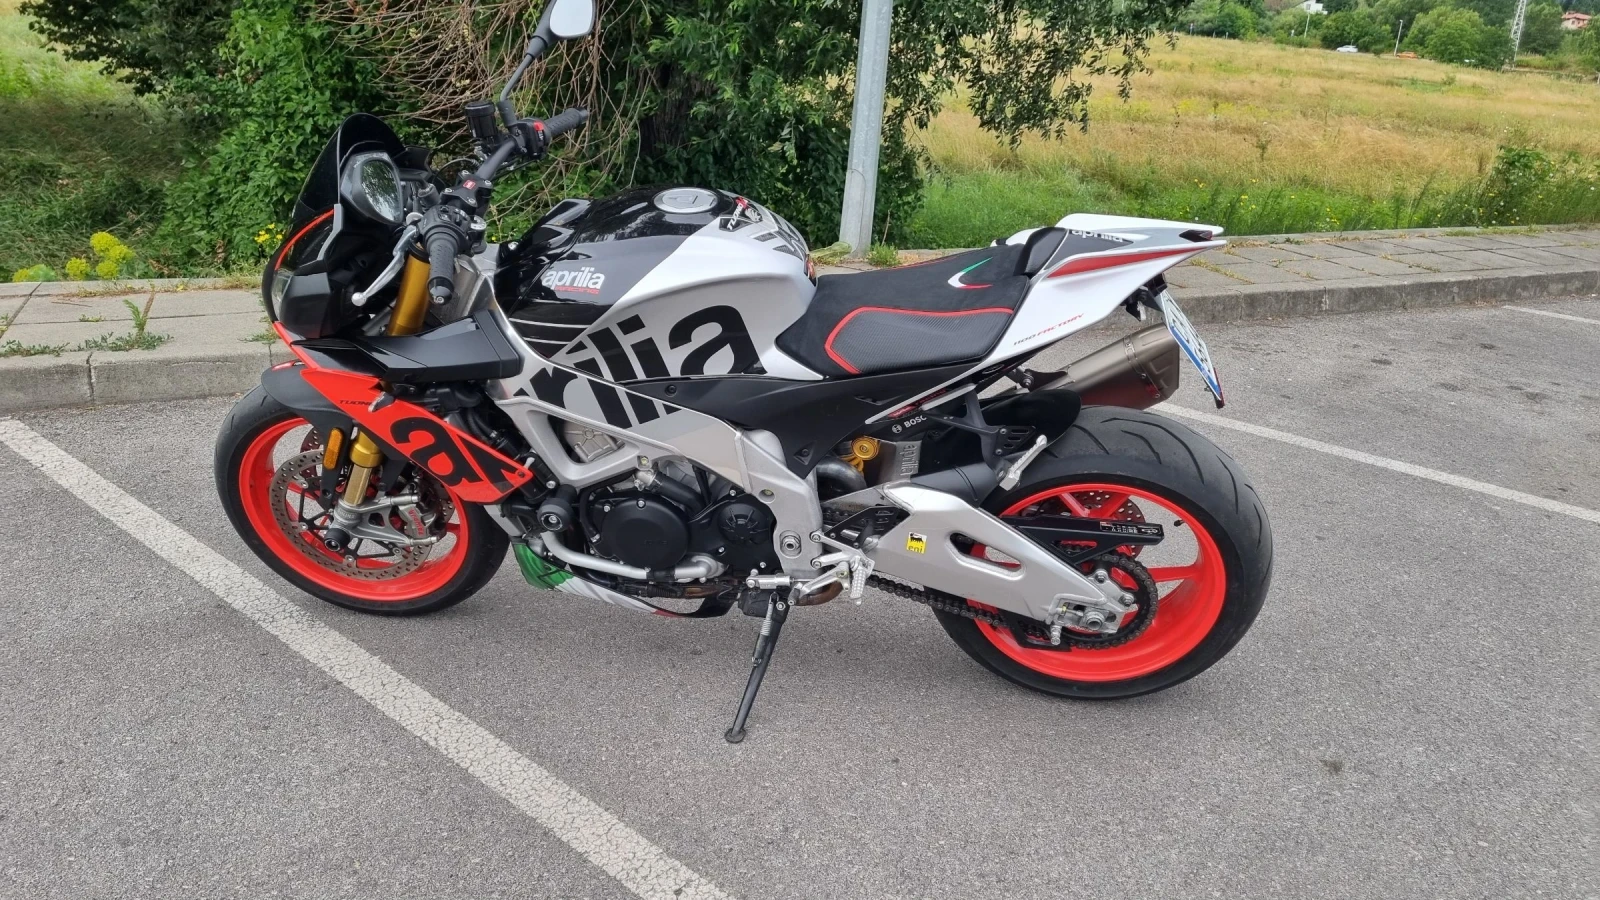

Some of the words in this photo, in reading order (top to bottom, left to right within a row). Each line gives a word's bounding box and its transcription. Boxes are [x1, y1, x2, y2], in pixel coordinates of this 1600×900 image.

[541, 266, 606, 290] aprilia
[1037, 313, 1085, 336] FACTORY
[904, 415, 928, 428] BOSC
[900, 444, 919, 477] aprilia
[907, 545, 924, 554] eni
